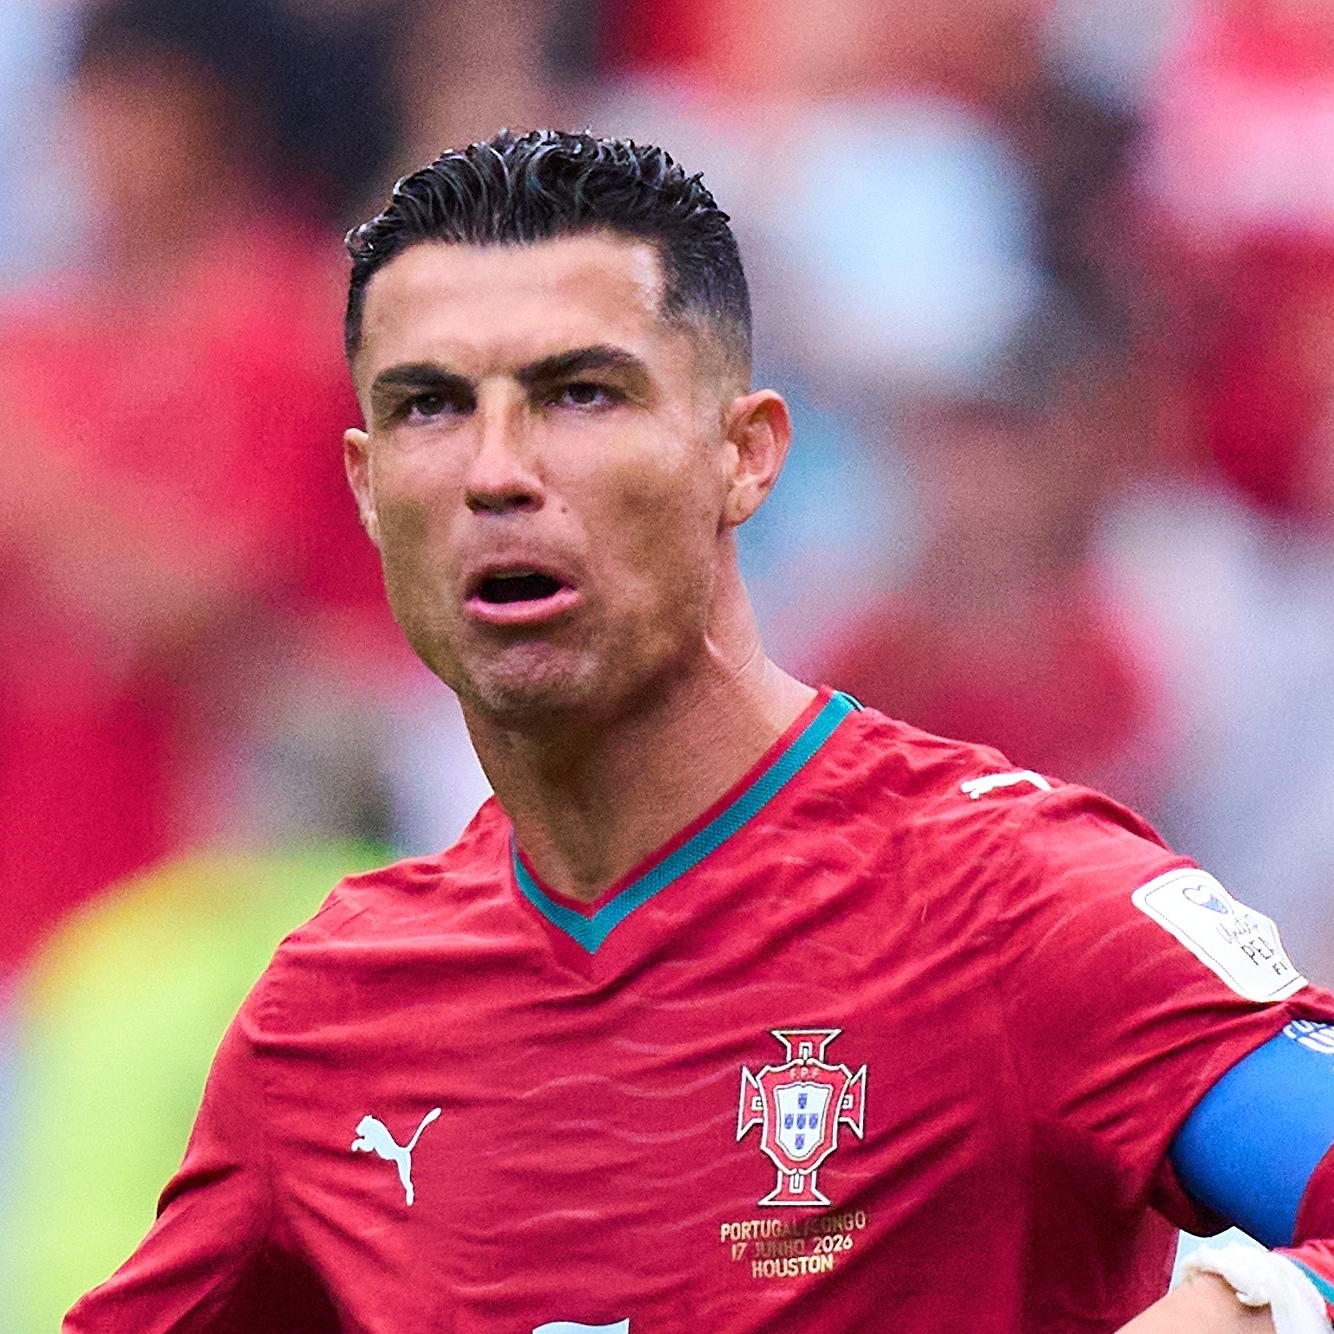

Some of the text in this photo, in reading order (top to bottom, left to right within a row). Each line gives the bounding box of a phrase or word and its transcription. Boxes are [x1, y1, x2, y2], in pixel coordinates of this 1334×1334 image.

[732, 1234, 853, 1260] 17 JUNHO 2026
[752, 1254, 832, 1278] HOUSTON
